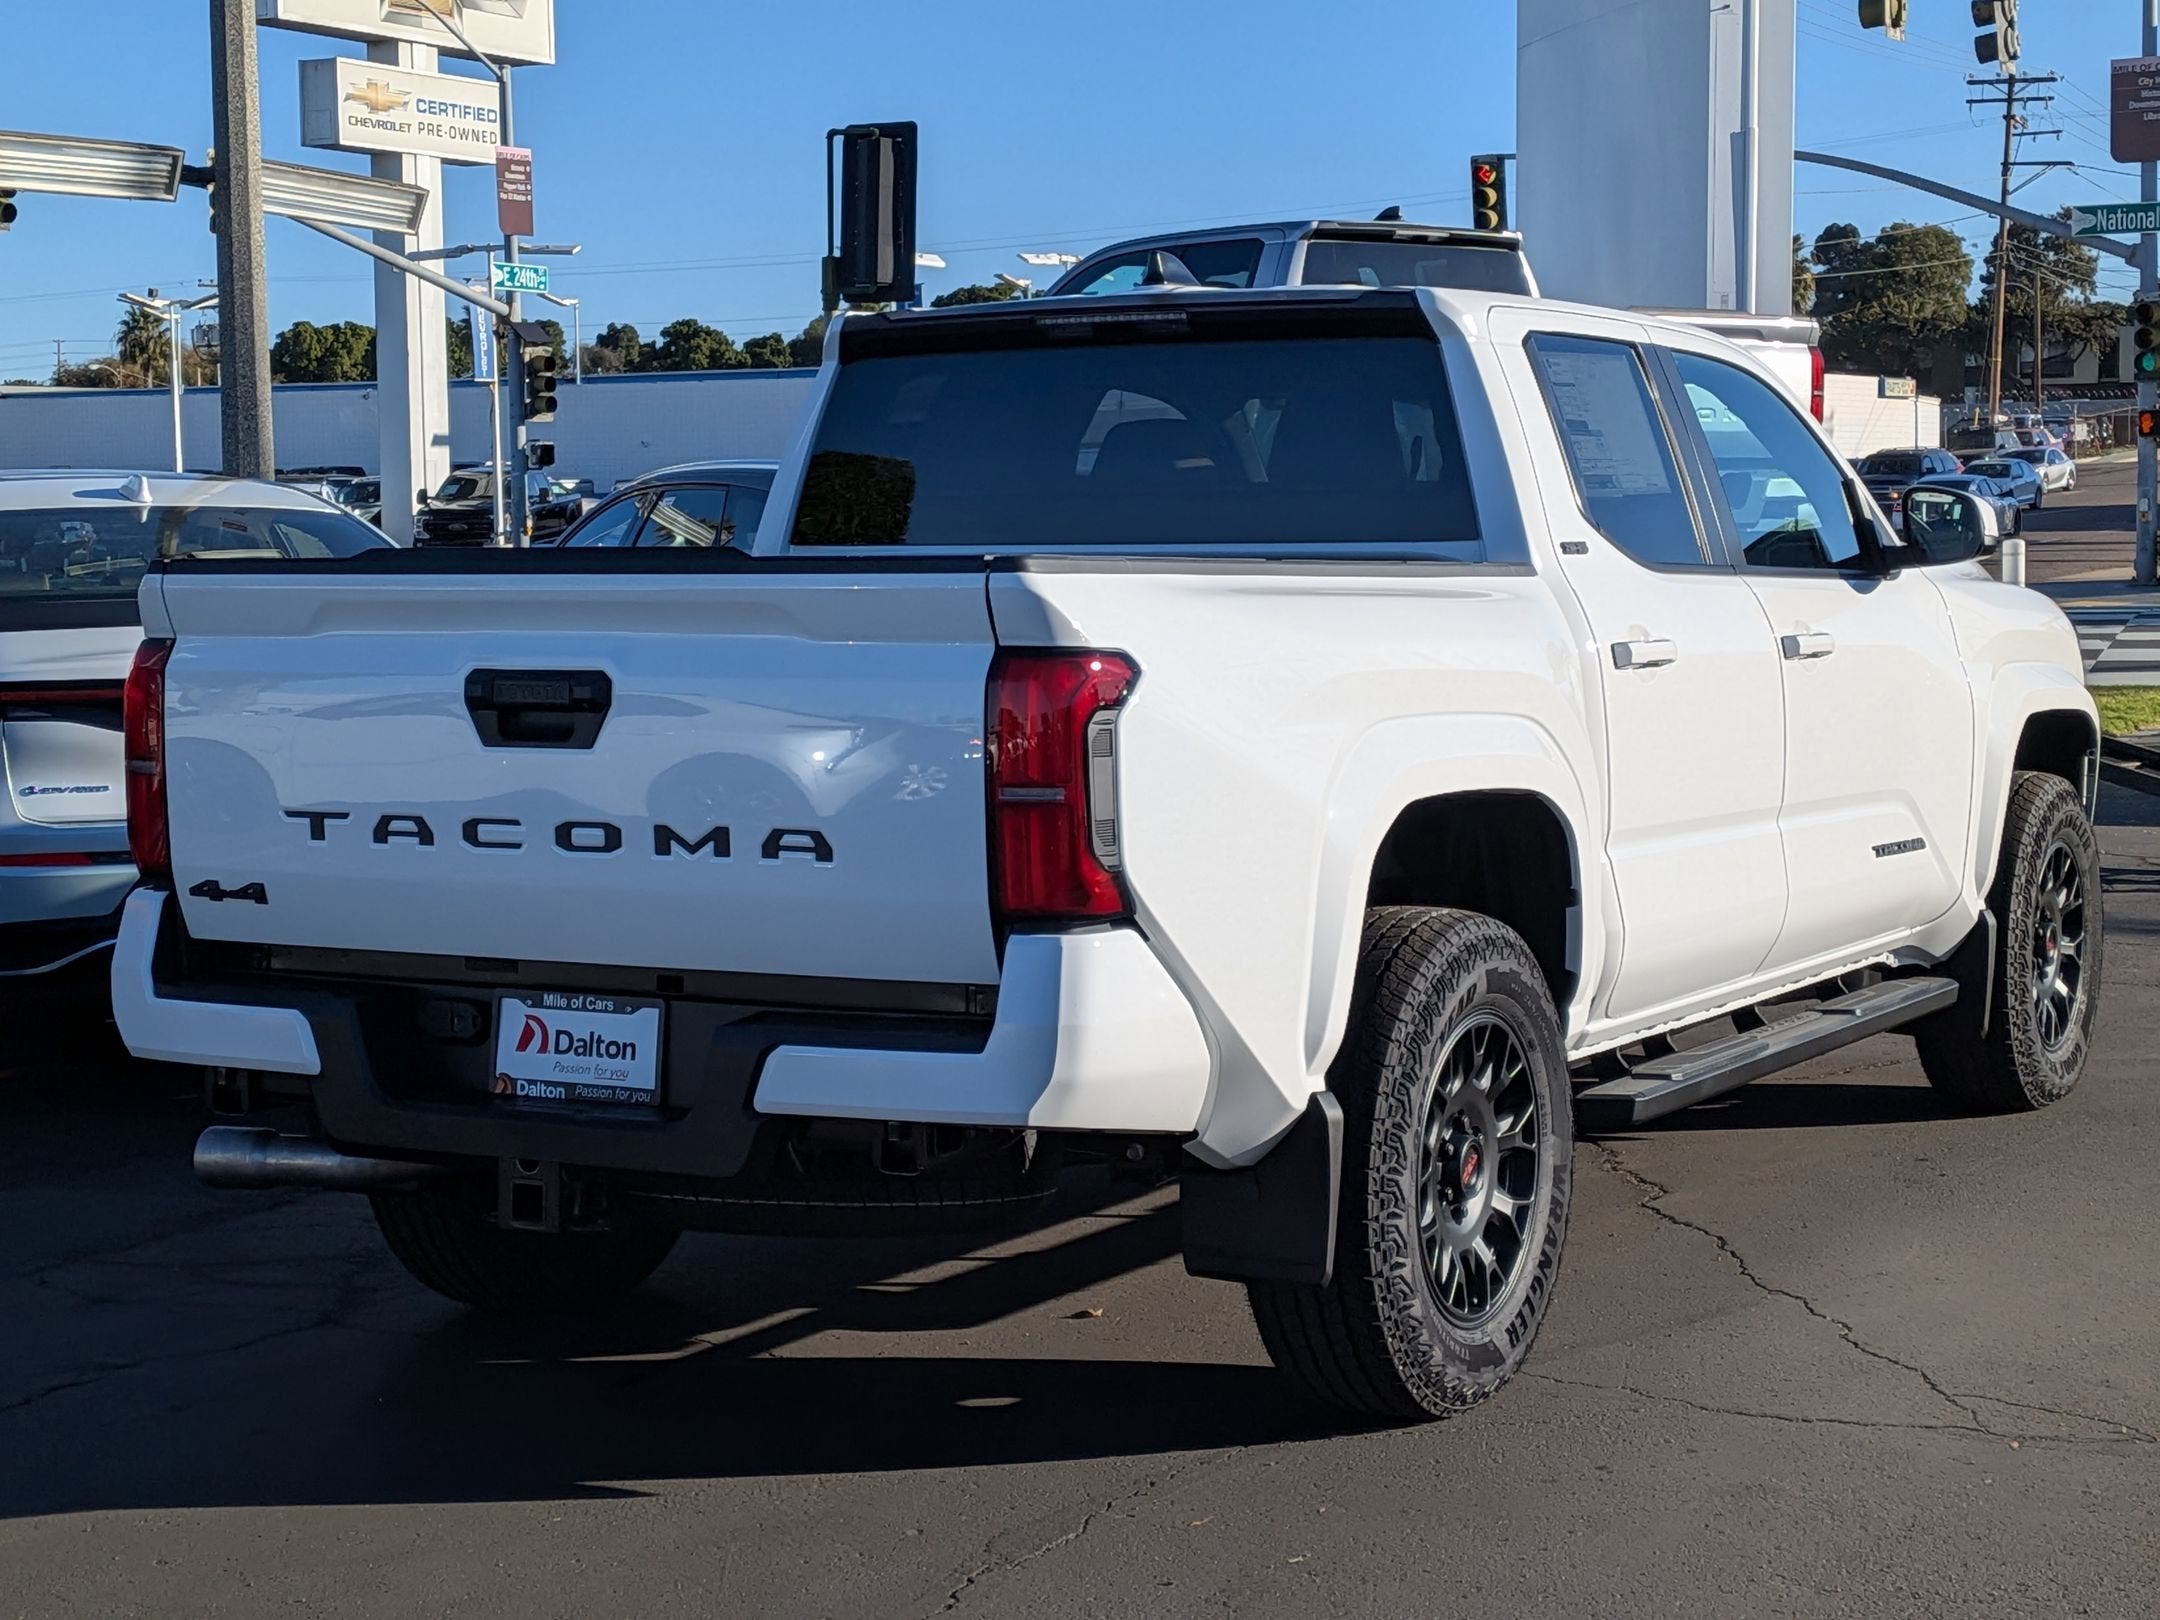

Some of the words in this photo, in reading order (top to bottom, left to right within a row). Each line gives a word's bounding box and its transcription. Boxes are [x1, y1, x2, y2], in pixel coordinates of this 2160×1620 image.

[416, 98, 498, 123] CERTIFIED
[348, 115, 412, 133] CHEVROLET
[417, 121, 498, 144] PRE-OWNED
[2096, 206, 2160, 231] National
[503, 267, 513, 287] E
[513, 268, 538, 288] 24th
[477, 305, 488, 377] HEVROLET
[283, 810, 834, 863] TACOMA
[543, 993, 568, 1008] Mile
[571, 996, 583, 1009] of
[586, 997, 614, 1011] Cars
[554, 1029, 637, 1061] Dalton
[553, 1061, 592, 1075] Passion
[594, 1063, 608, 1077] for
[610, 1067, 630, 1078] you
[516, 1080, 566, 1099] Dalton
[575, 1084, 613, 1099] Passion
[615, 1088, 630, 1100] for
[631, 1091, 652, 1103] you
[1504, 1164, 1567, 1349] WRANGLER
